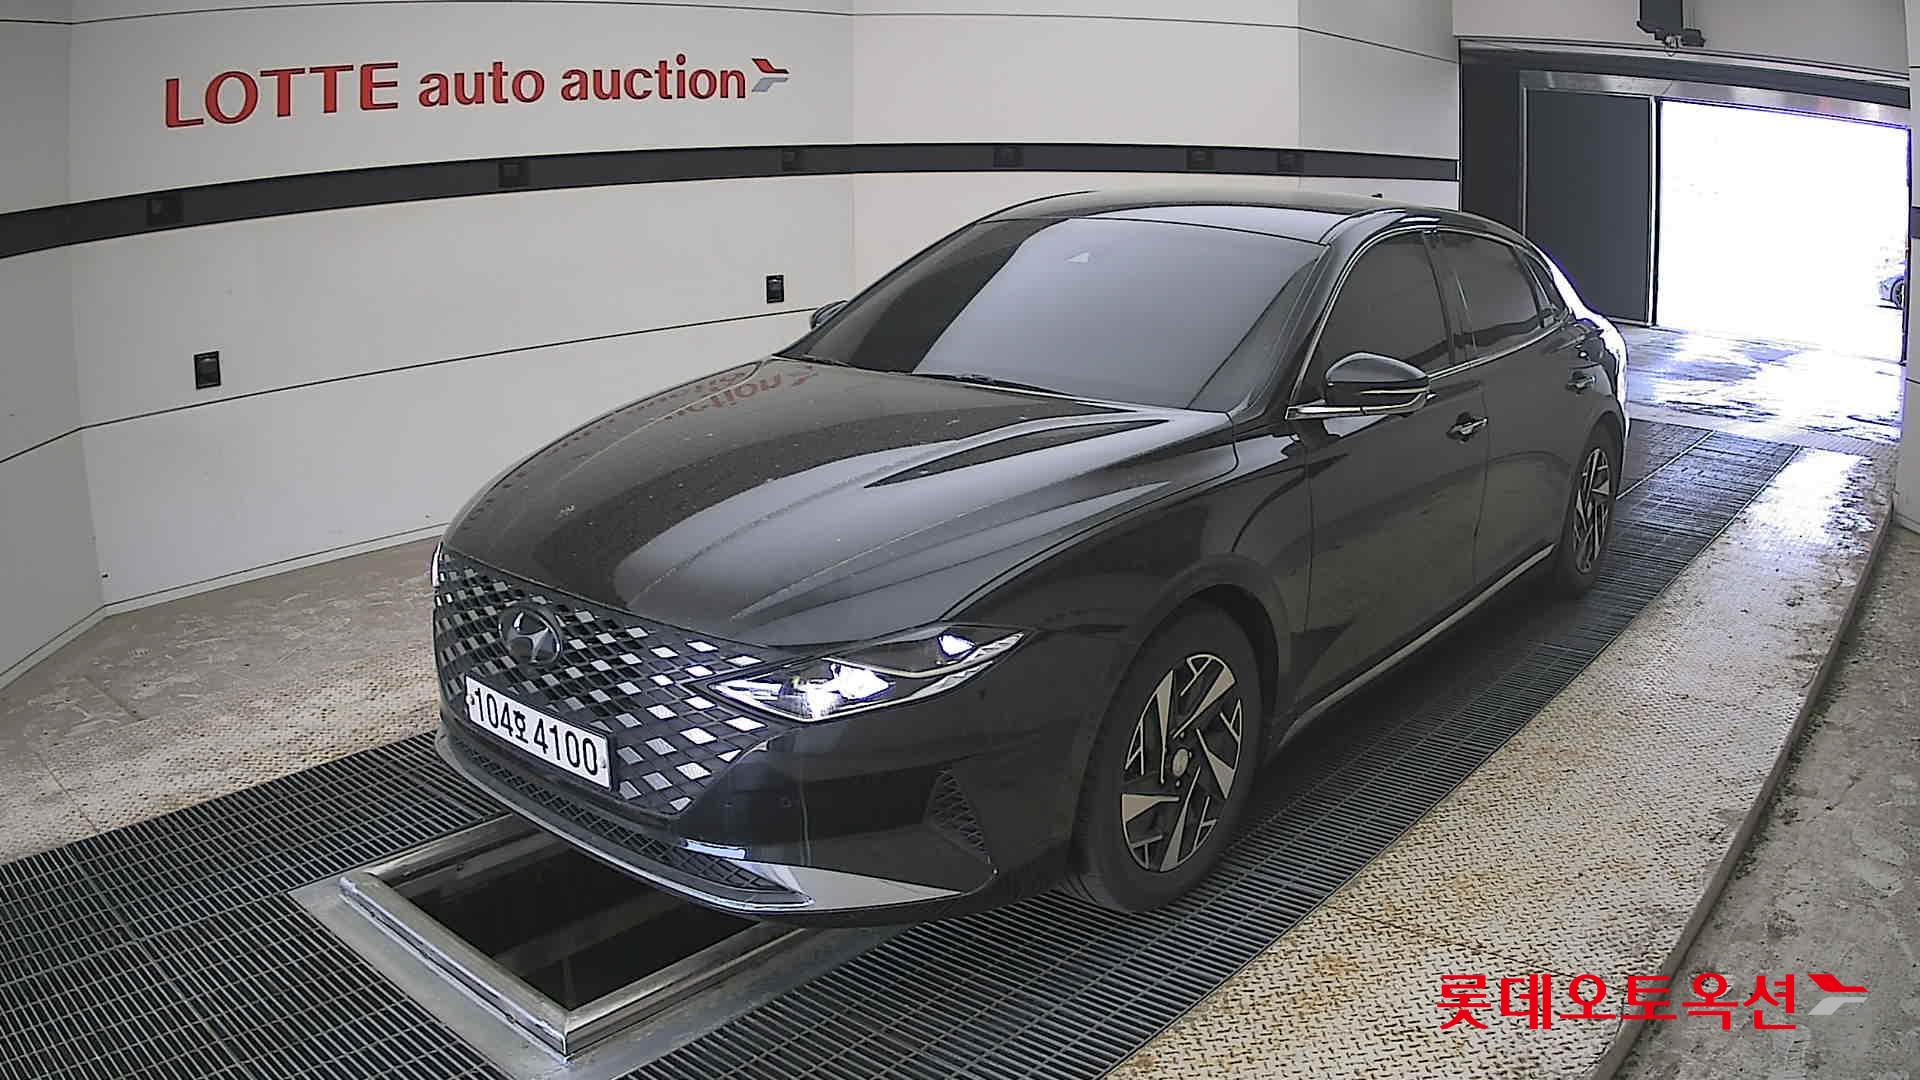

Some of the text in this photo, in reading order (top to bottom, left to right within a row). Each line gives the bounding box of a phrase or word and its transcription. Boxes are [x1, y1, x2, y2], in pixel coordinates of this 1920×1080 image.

[164, 53, 747, 129] LOTTE auto auction
[474, 687, 598, 776] 104호 4100
